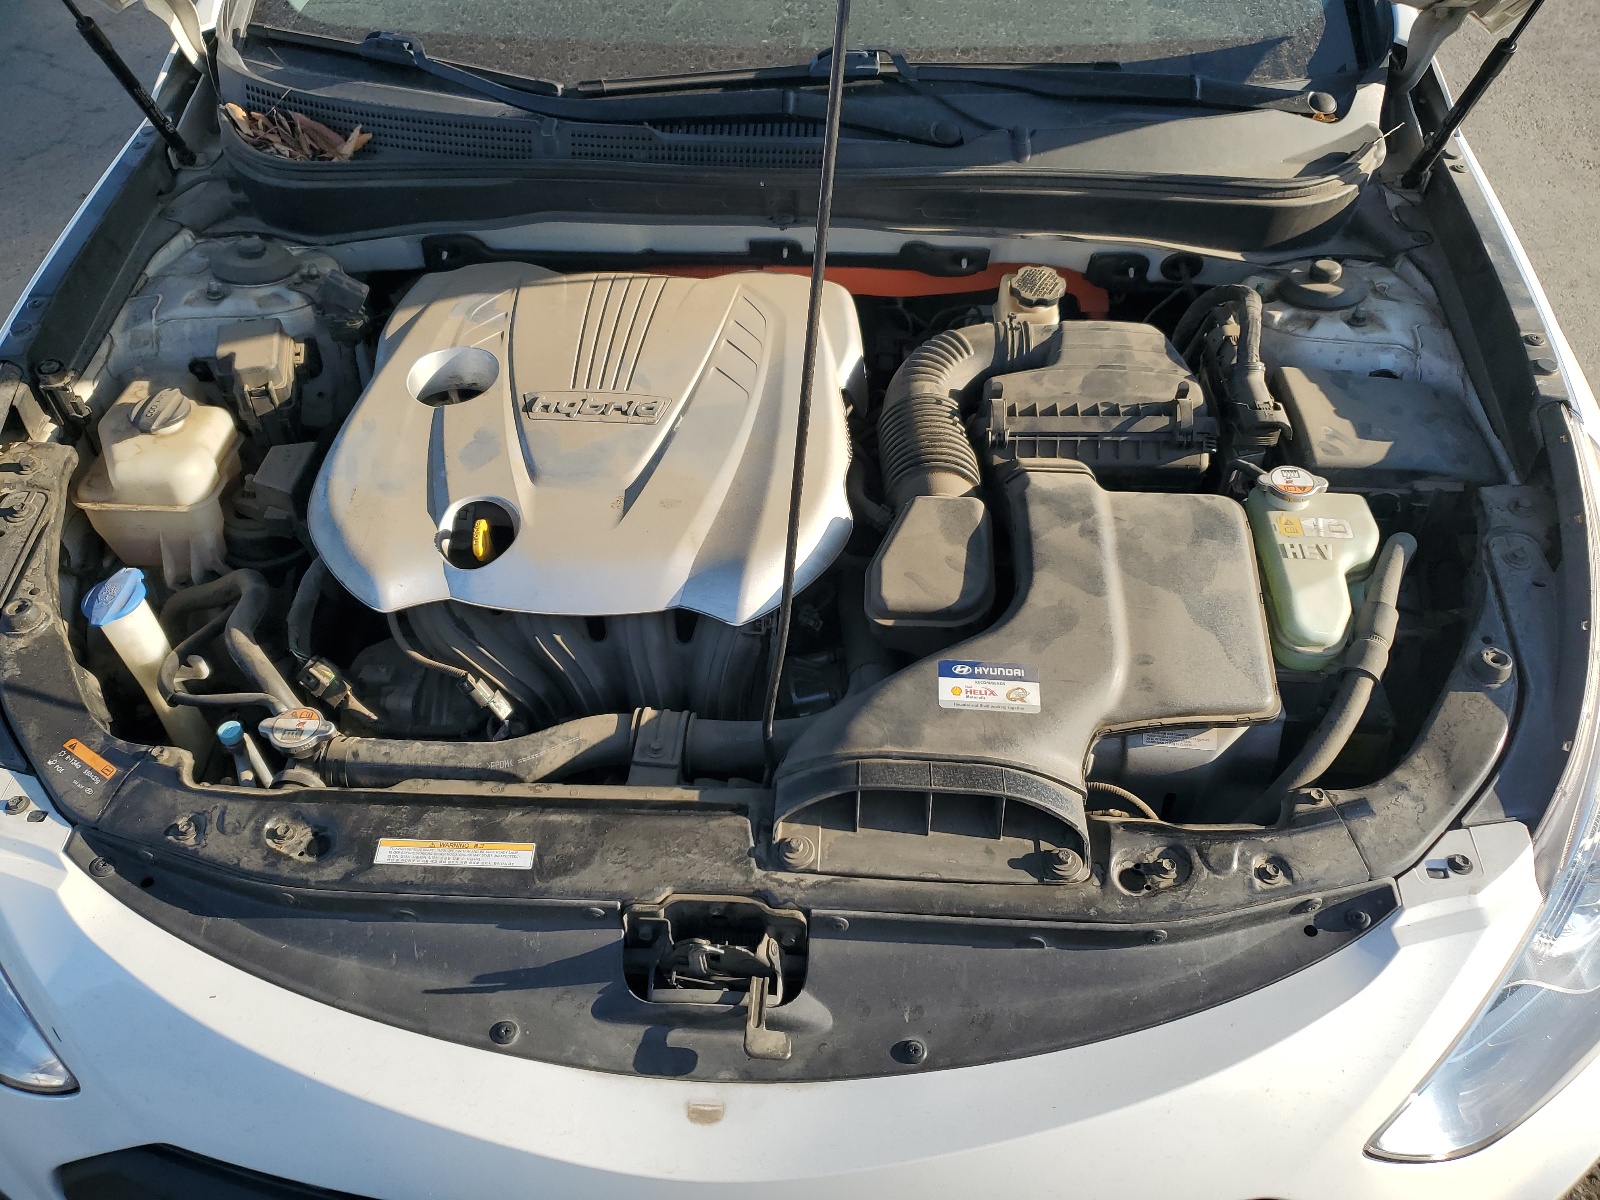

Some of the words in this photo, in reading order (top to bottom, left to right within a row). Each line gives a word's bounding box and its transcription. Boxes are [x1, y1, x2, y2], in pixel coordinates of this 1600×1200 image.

[531, 396, 666, 418] hybrid
[1279, 543, 1333, 560] HEV
[974, 666, 1025, 677] HYUNDAI
[965, 688, 996, 696] HELIX
